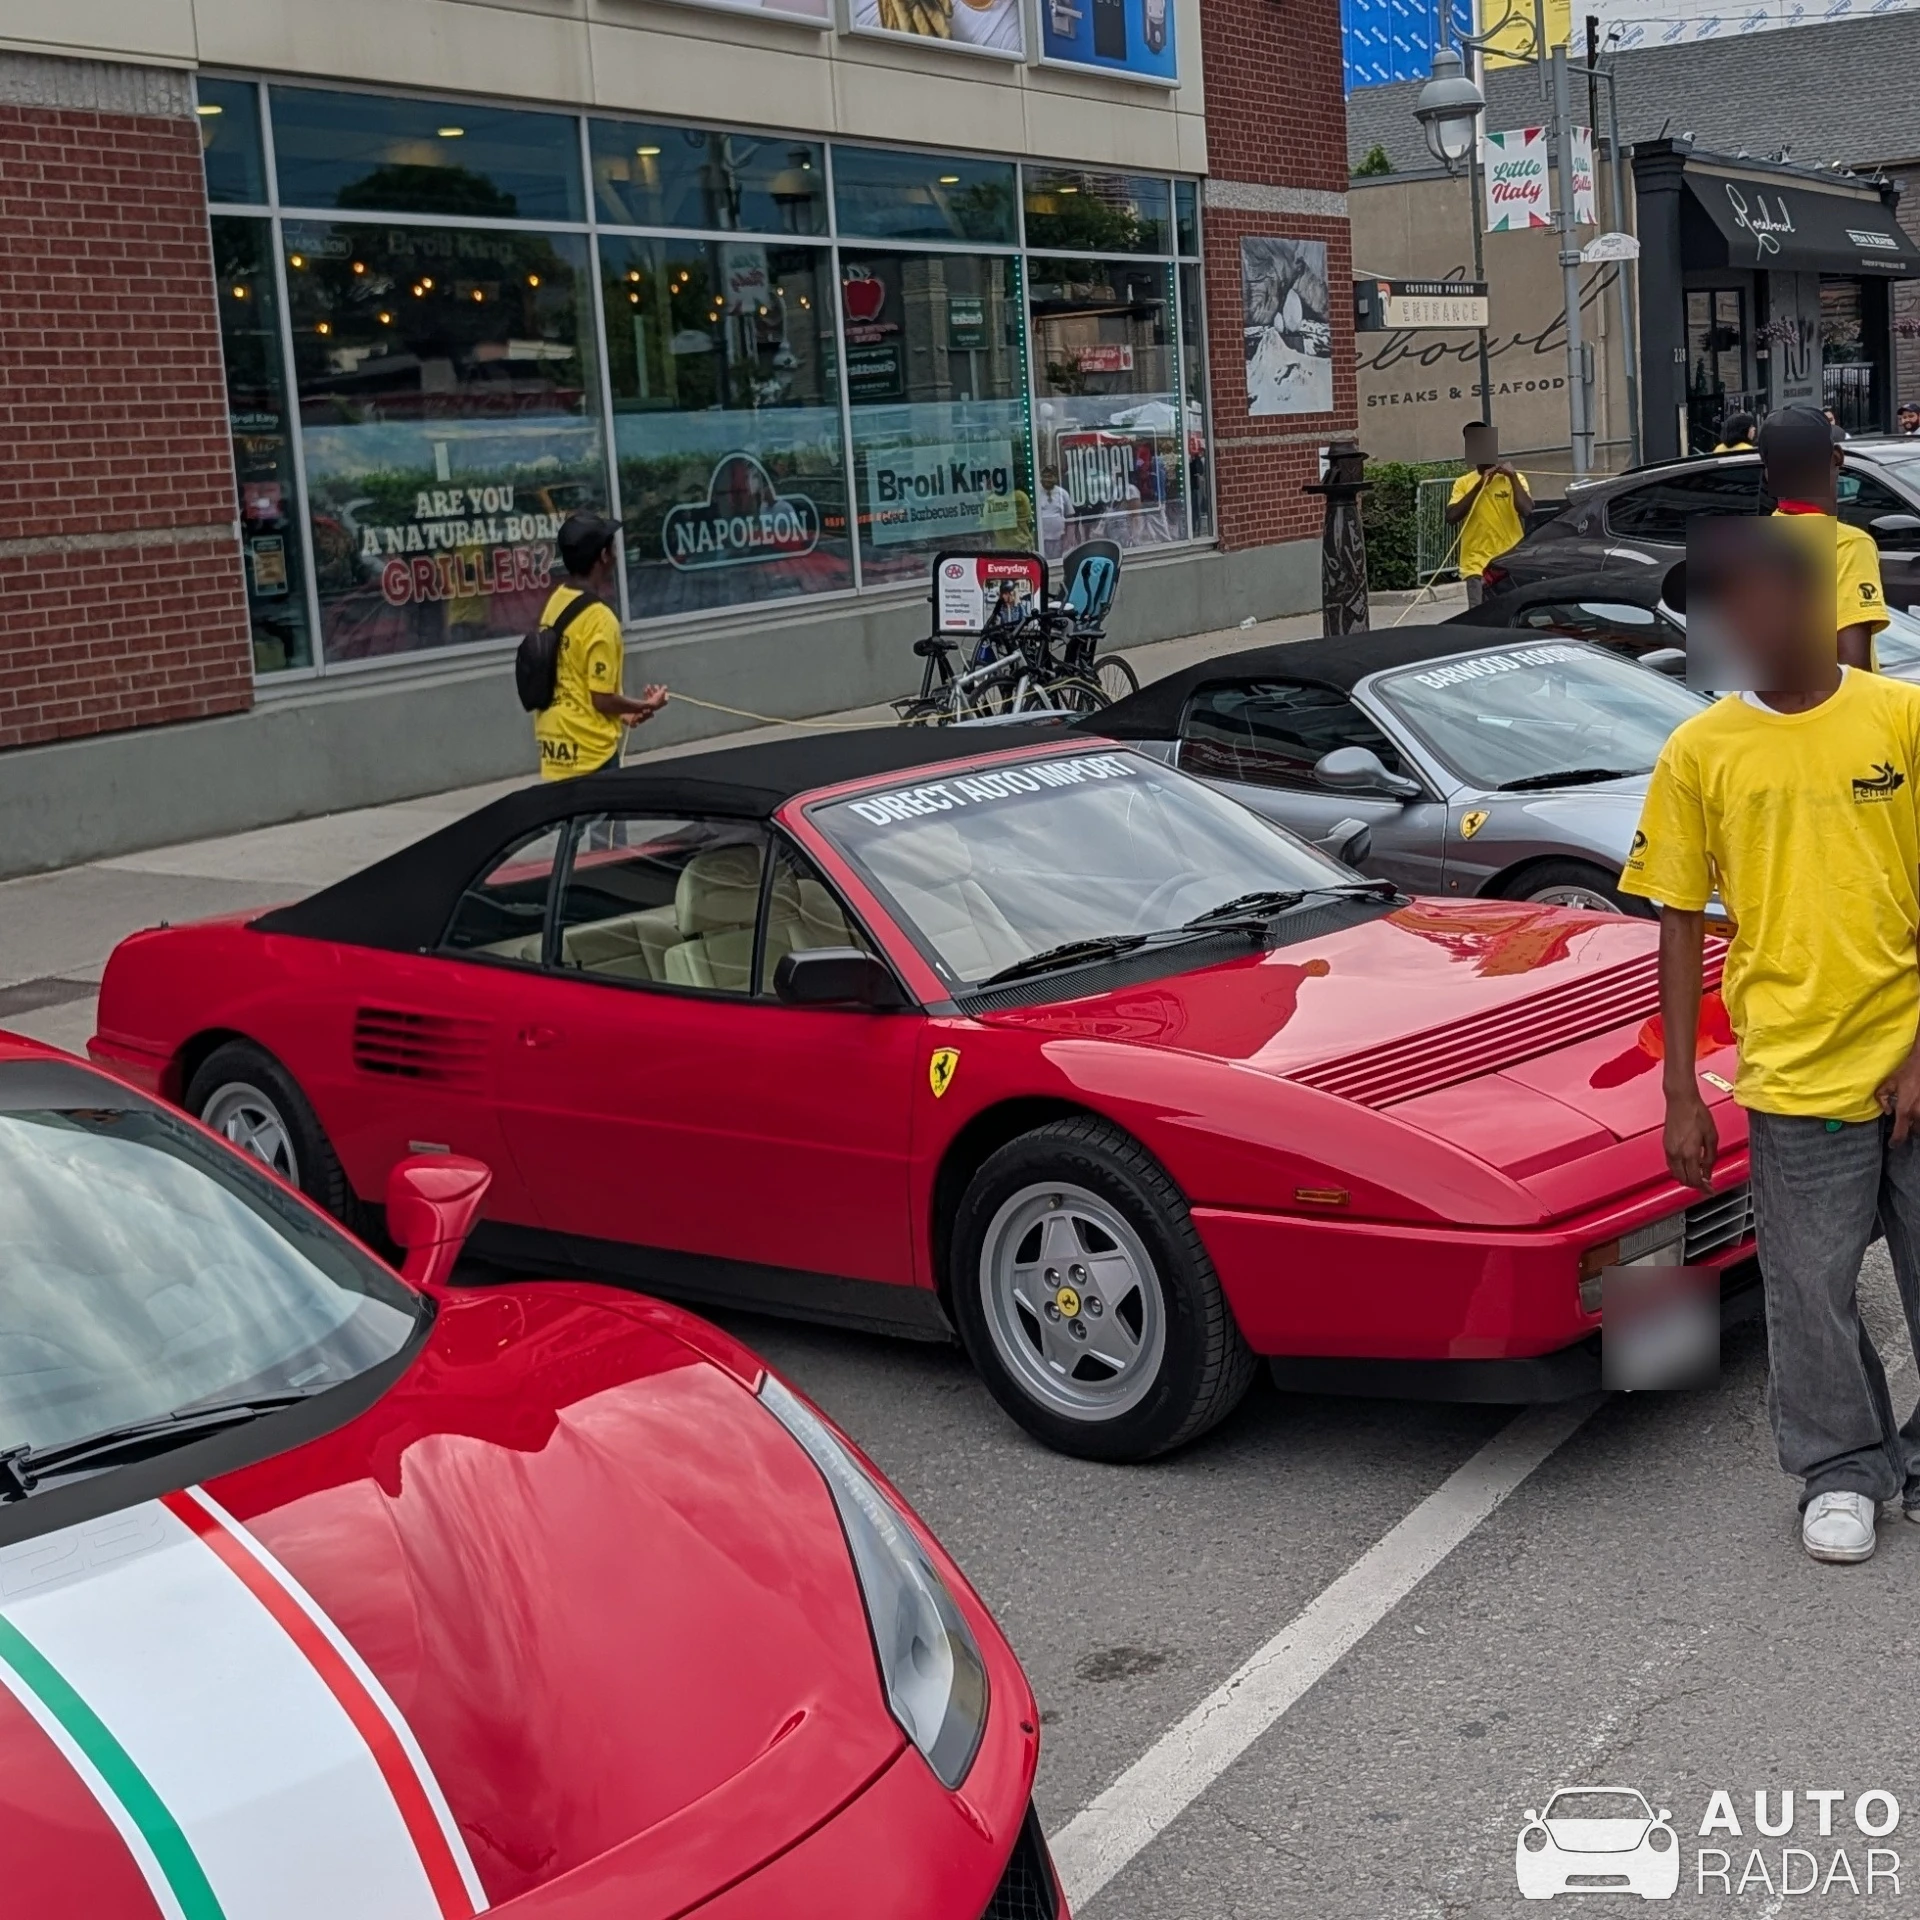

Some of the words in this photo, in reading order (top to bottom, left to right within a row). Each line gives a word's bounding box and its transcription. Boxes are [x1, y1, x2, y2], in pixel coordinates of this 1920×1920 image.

[1493, 158, 1542, 182] Little
[1492, 179, 1543, 204] Italy
[1405, 284, 1442, 293] CUSTOMER
[1446, 285, 1474, 294] PARKING
[1402, 301, 1479, 322] ENTRANCE
[1367, 389, 1438, 407] STEAKS
[1449, 387, 1461, 399] &
[1471, 378, 1565, 397] SEAFOOD
[877, 464, 944, 502] Broil
[950, 463, 1007, 496] King
[415, 489, 465, 519] ARE
[467, 485, 515, 513] YOU
[910, 504, 959, 522] Barbecues
[960, 502, 985, 518] Every
[987, 500, 1010, 512] Time
[361, 525, 382, 556] A
[385, 517, 504, 553] NATURAL
[505, 513, 567, 541] BORN
[674, 510, 808, 556] NAPOLEON
[382, 544, 556, 606] GRILLER?
[988, 563, 1030, 575] Everyday.
[1413, 655, 1521, 690] BARWOOD
[541, 740, 580, 761] NA!
[848, 784, 968, 826] DIRECT
[953, 768, 1041, 803] AUTO
[1023, 755, 1137, 788] IMPORT
